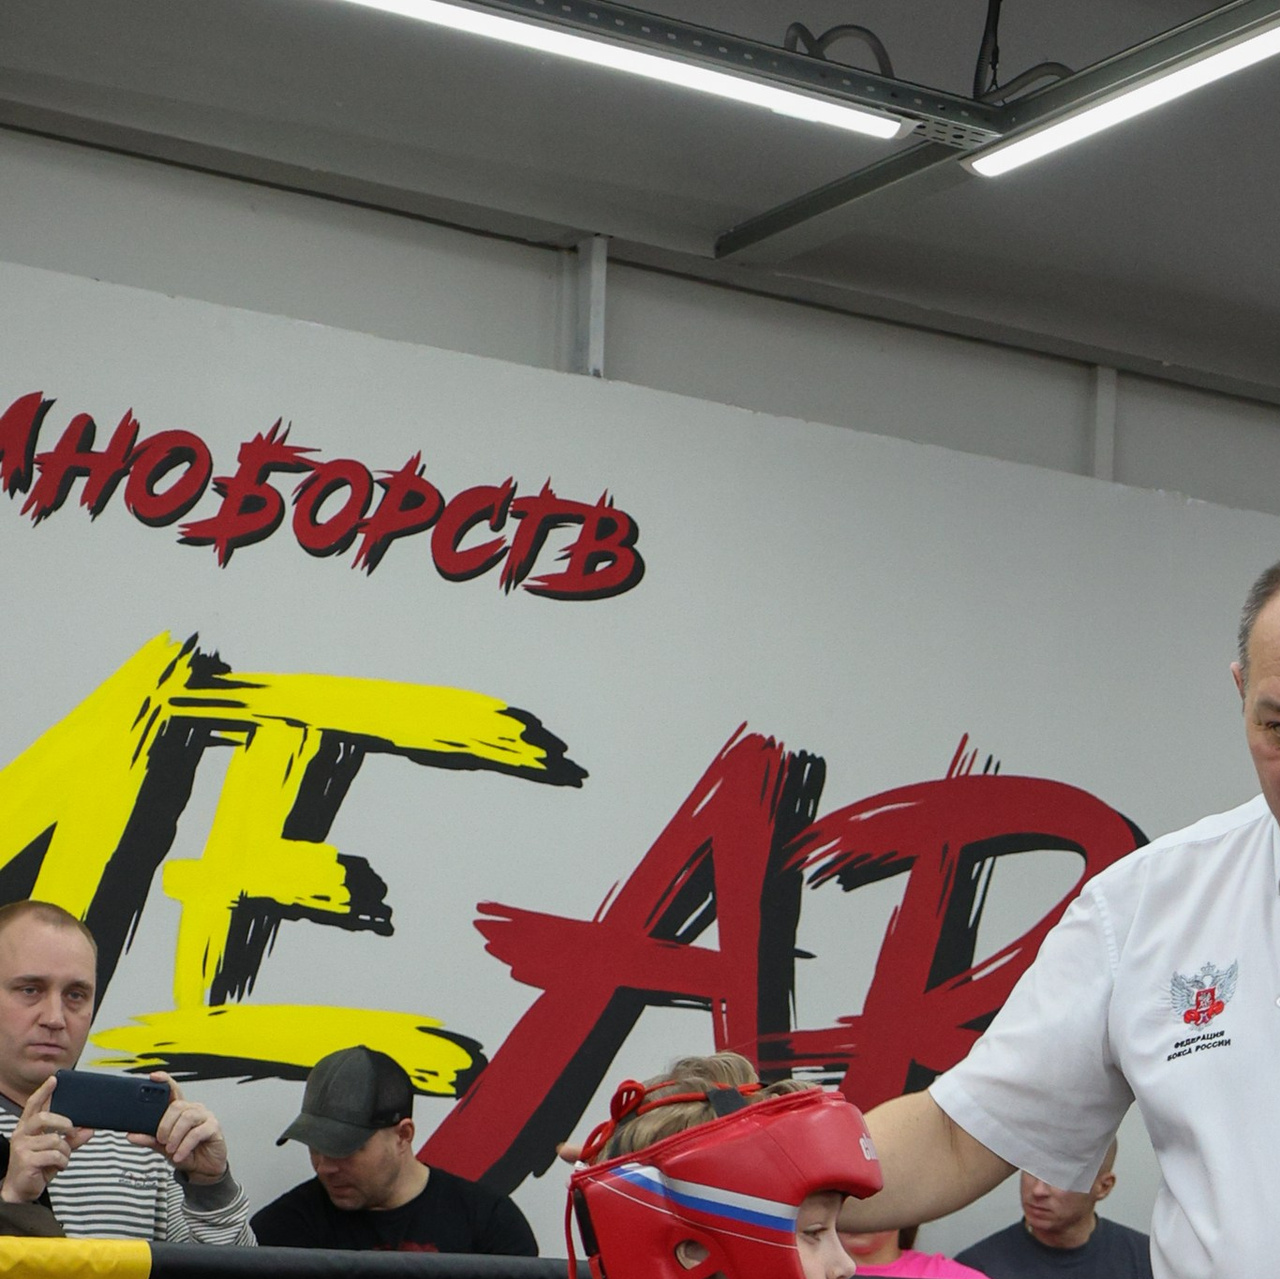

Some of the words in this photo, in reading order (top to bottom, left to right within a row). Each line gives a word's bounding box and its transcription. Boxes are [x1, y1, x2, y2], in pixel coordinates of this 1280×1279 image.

[1167, 1047, 1192, 1062] БОКСА
[1195, 1038, 1231, 1052] РОССИИ
[1174, 1030, 1225, 1049] ФЕДЕРАЦИЯ
